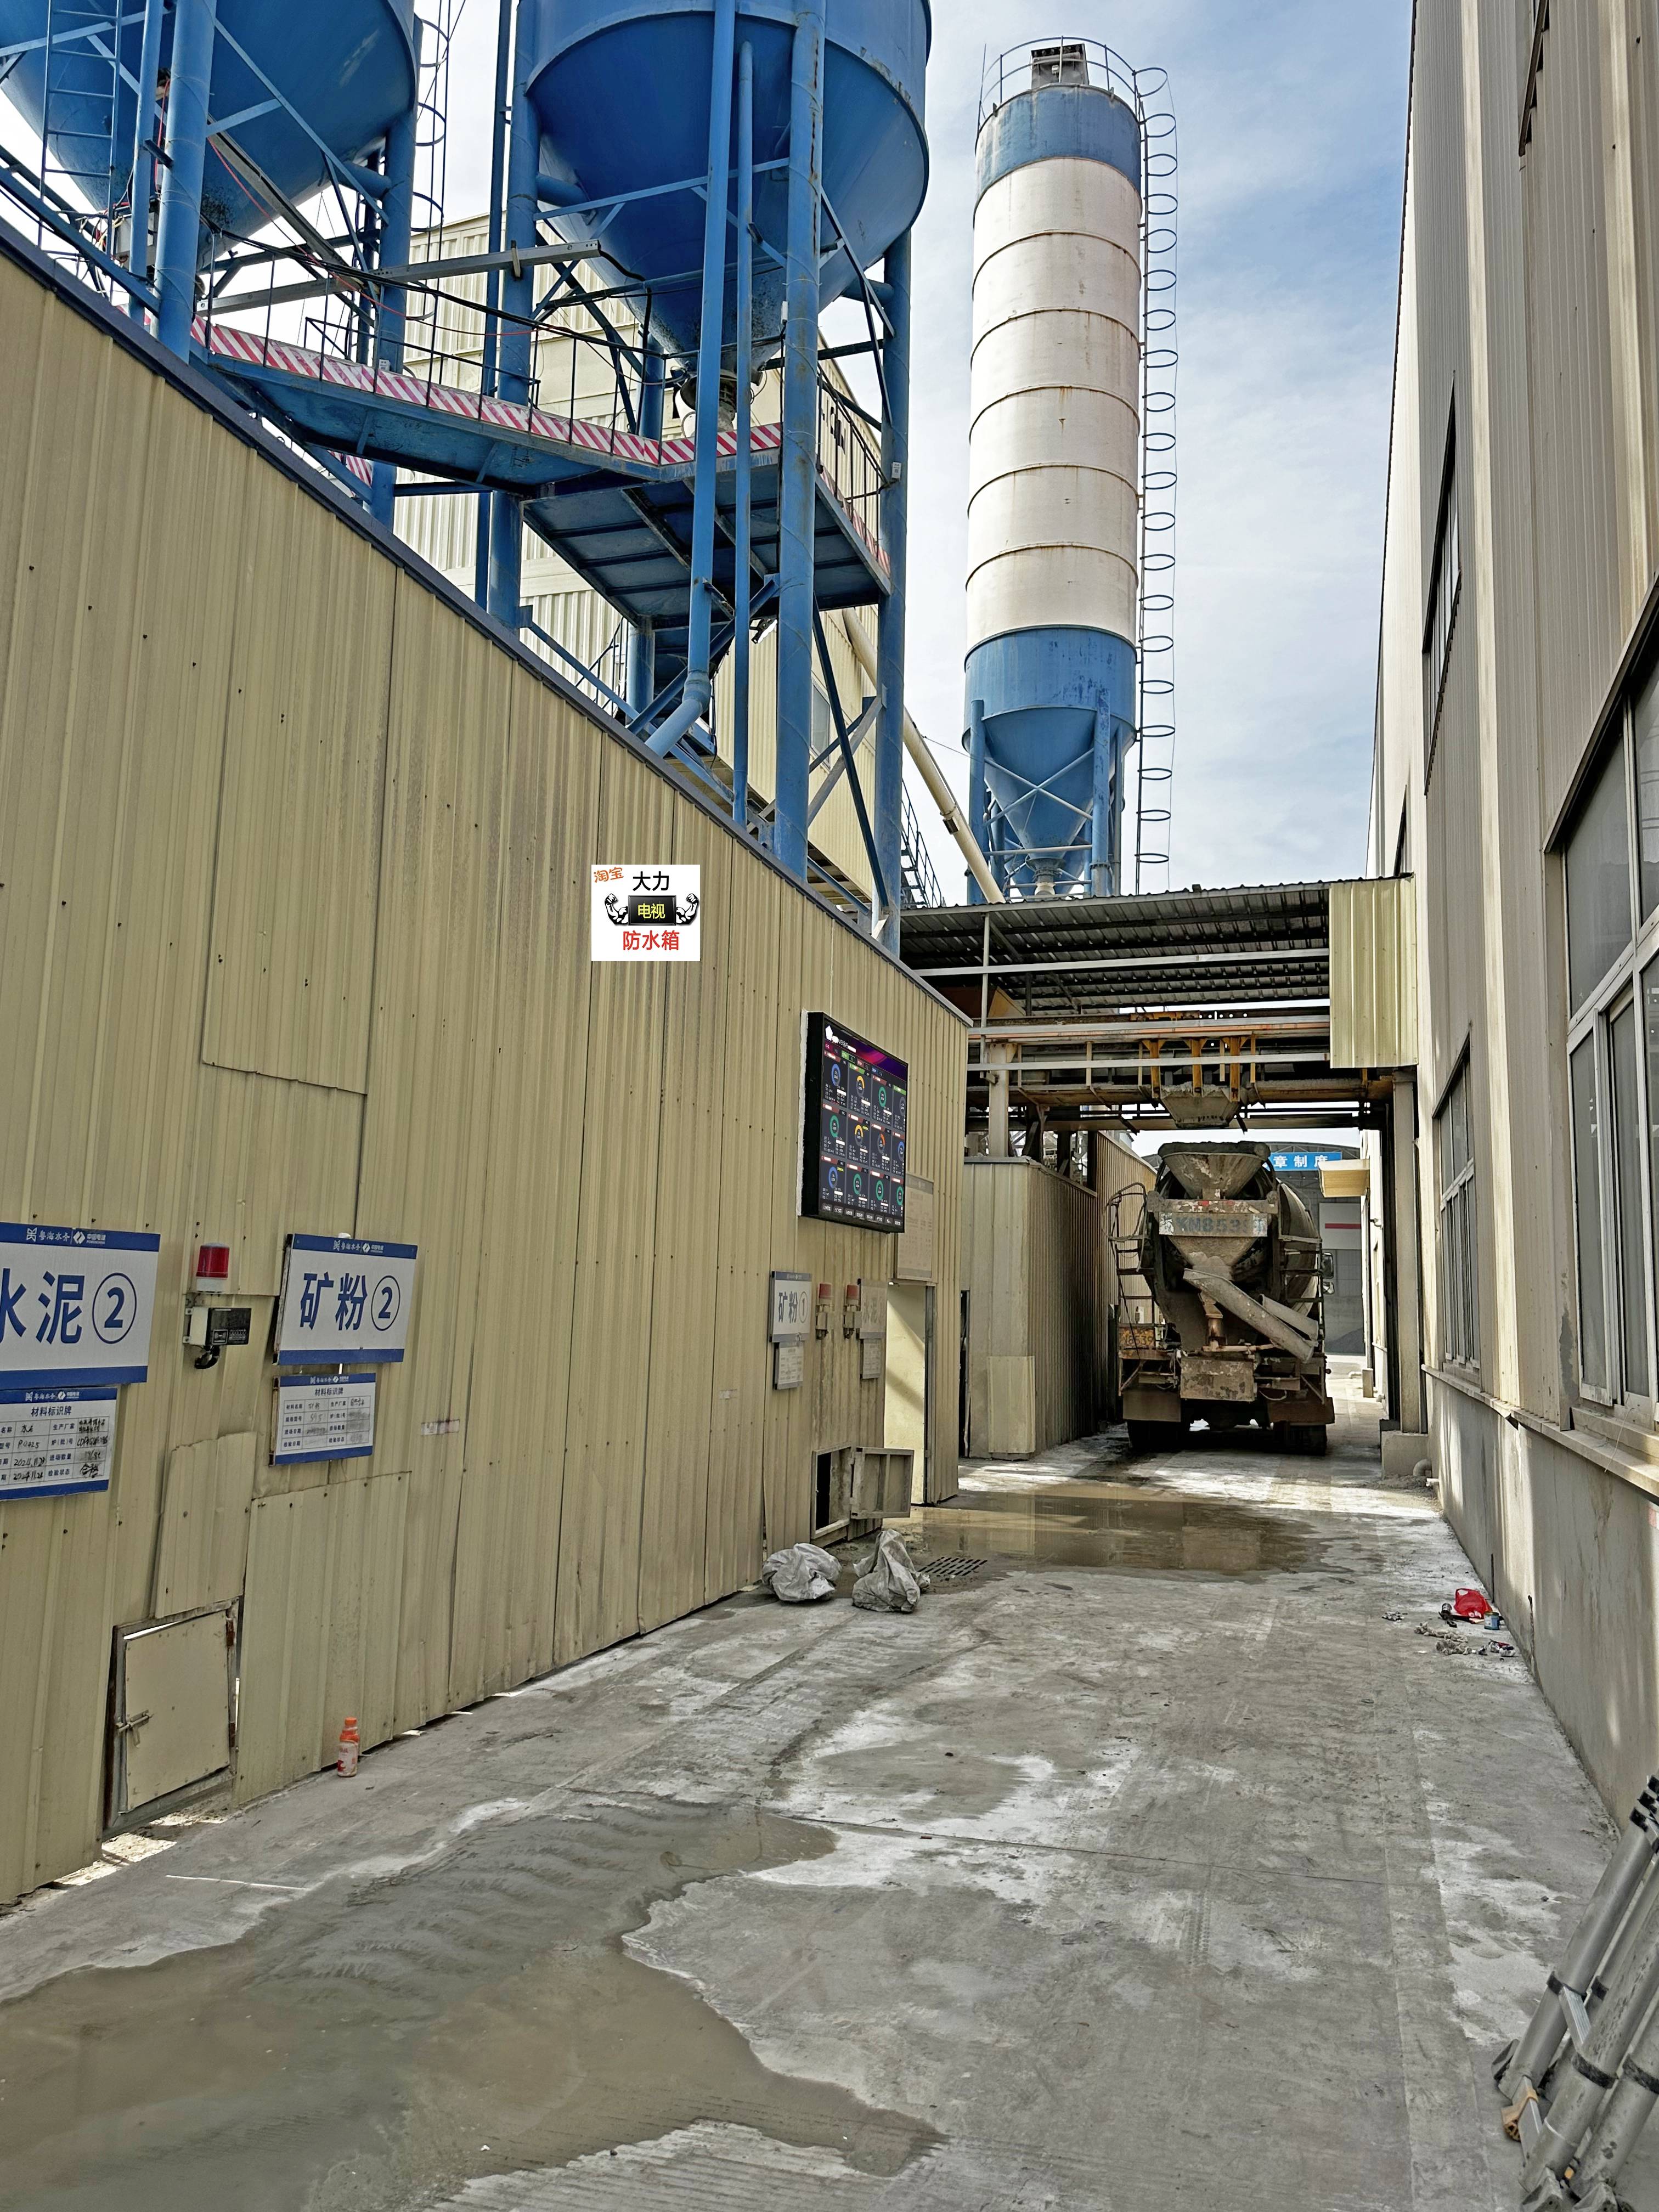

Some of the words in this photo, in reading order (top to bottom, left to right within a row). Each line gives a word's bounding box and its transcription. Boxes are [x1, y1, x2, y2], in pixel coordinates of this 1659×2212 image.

[1262, 1155, 1328, 1167] 章制度
[31, 1406, 72, 1417] 材料标识牌
[53, 1423, 75, 1431] 生产厂家
